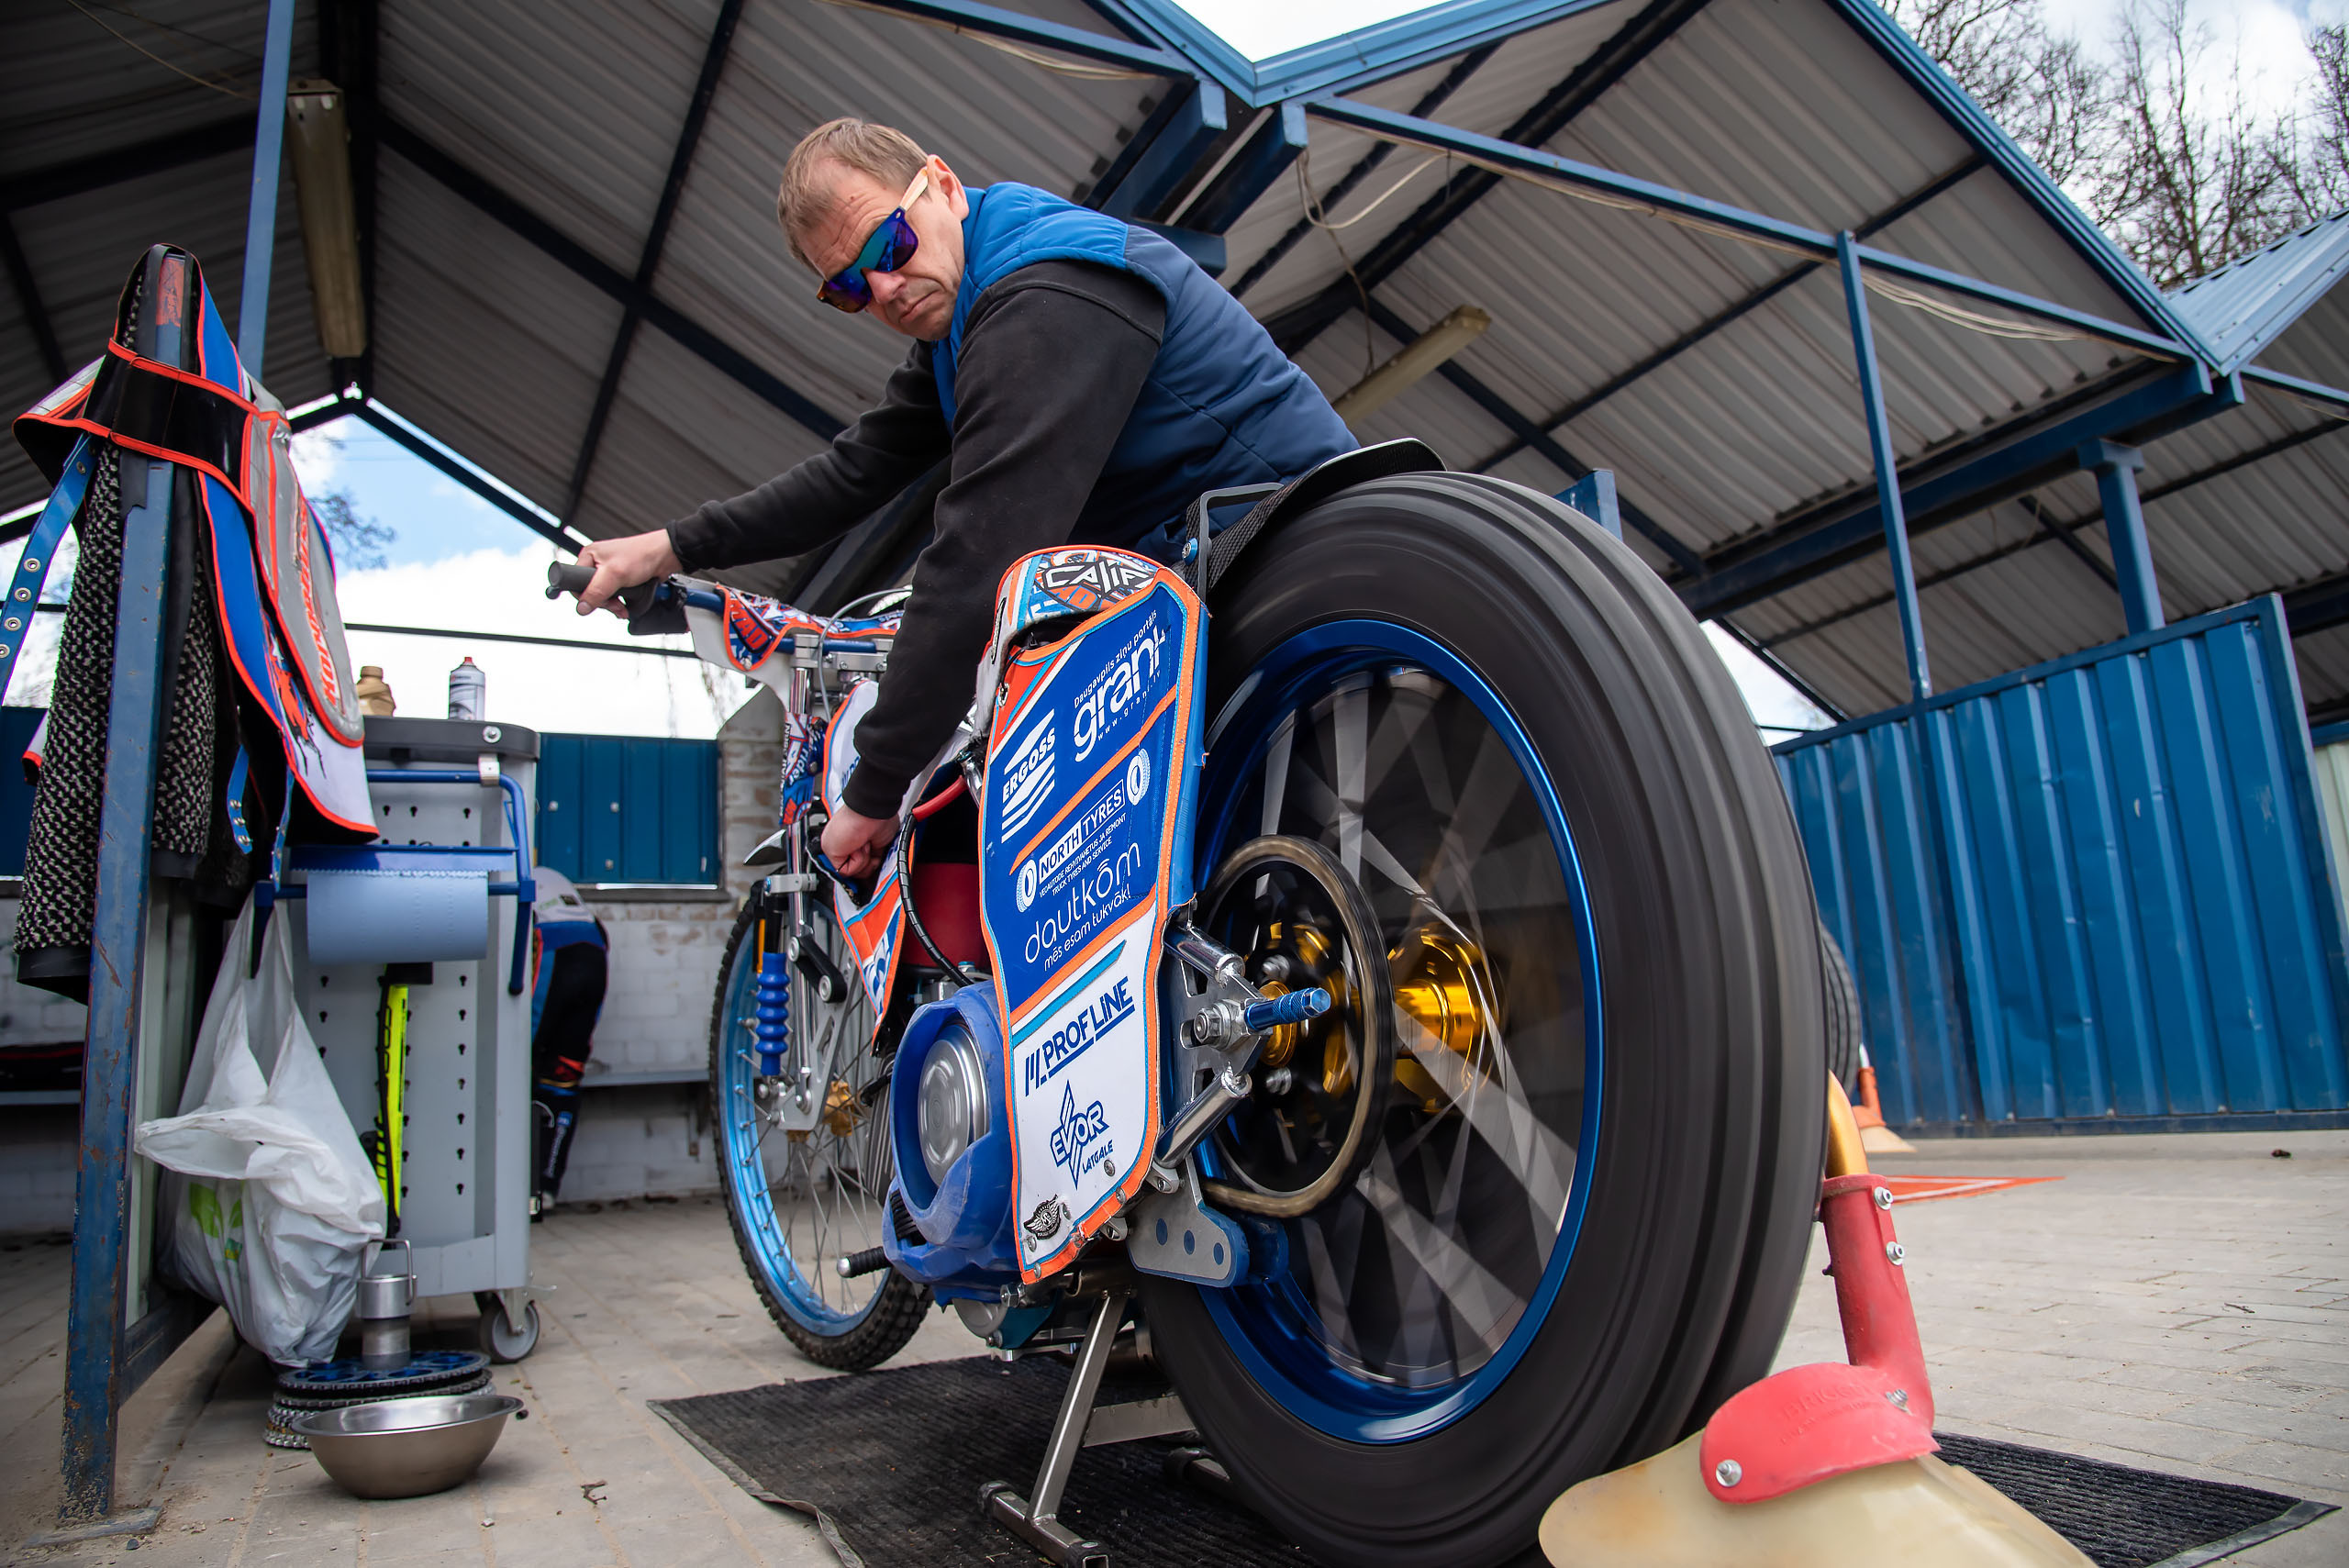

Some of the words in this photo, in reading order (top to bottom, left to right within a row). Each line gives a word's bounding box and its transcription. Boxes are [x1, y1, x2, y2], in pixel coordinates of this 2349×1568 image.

[1074, 660, 1115, 709] Daugavpils
[1002, 727, 1056, 804] ERGOSS
[1040, 828, 1080, 879] NORTH
[1083, 787, 1123, 837] TYRES
[1052, 877, 1068, 896] TRUCK
[1066, 864, 1082, 883] TYRES
[1081, 857, 1093, 871] AND
[1092, 836, 1113, 861] SERVICE
[1044, 945, 1063, 972] mēs
[1063, 921, 1091, 951] esam
[1051, 1089, 1110, 1178] EVOR
[1082, 1139, 1114, 1174] LATGALE
